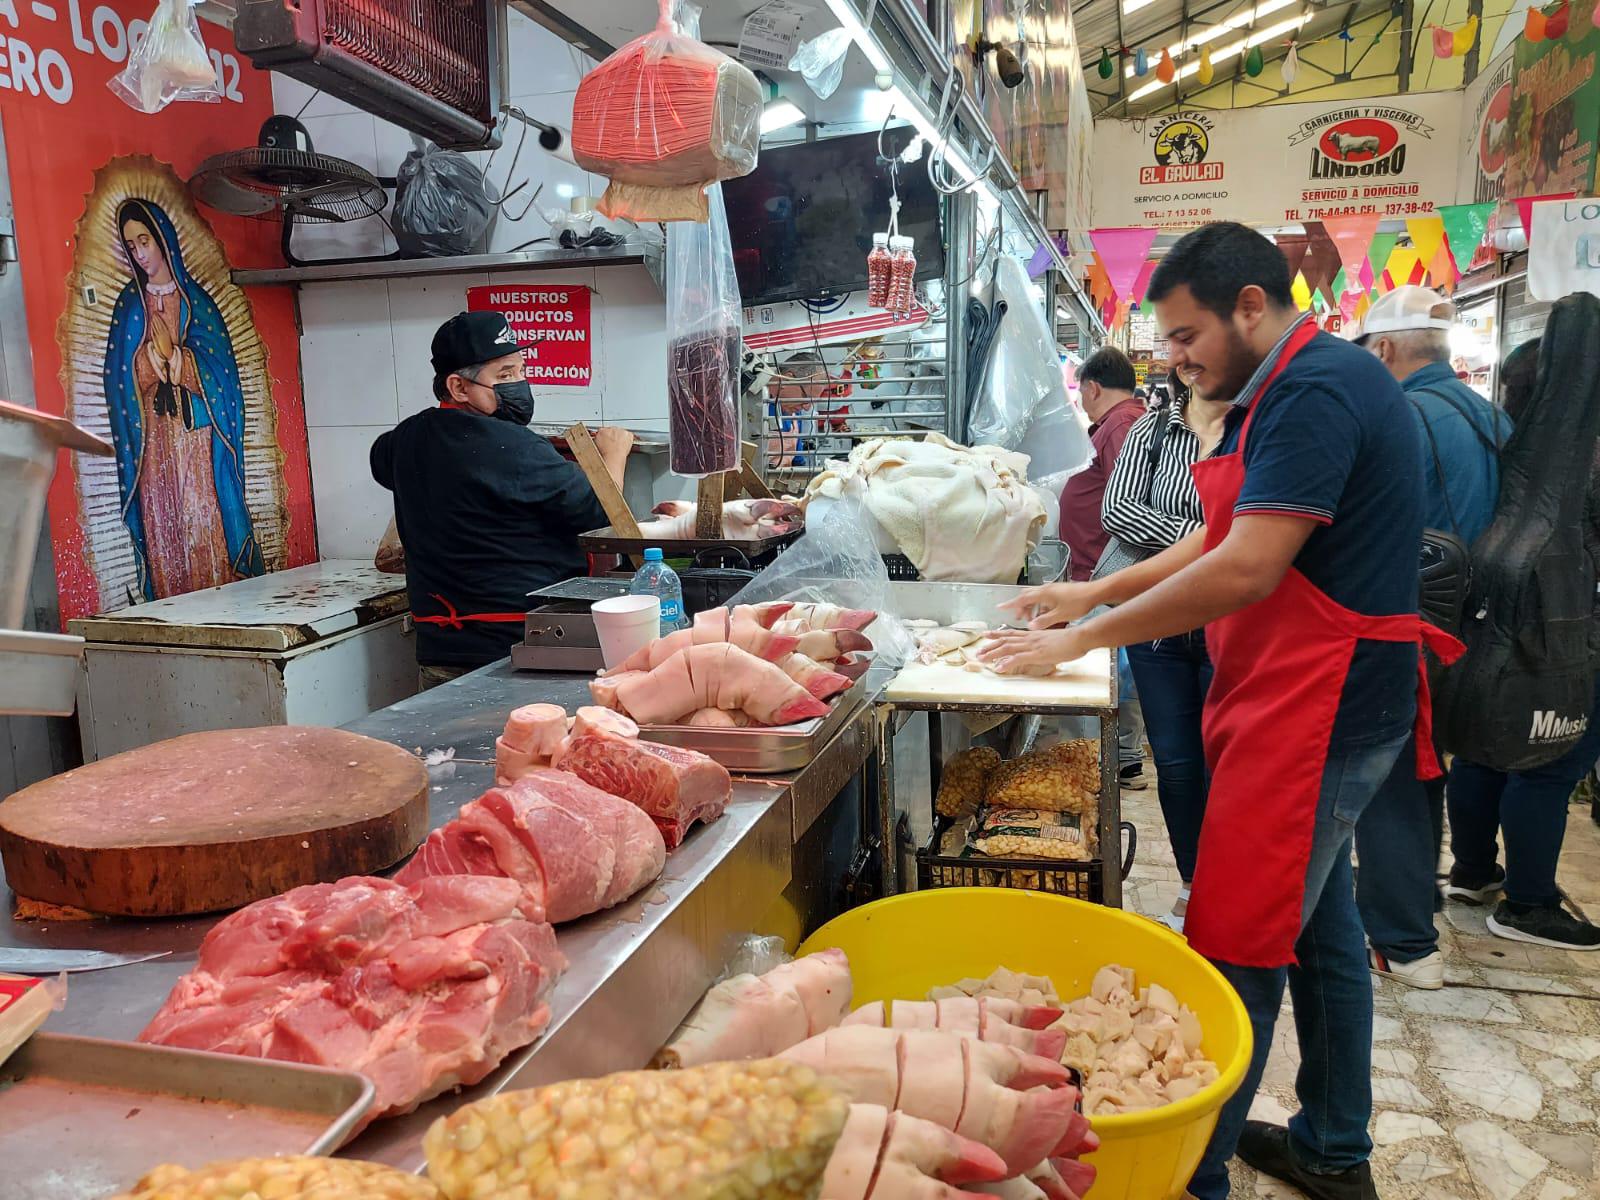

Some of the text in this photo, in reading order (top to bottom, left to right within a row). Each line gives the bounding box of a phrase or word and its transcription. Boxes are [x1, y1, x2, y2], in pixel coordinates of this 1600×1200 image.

[1304, 108, 1419, 131] CARNICERIA Y VISCERAS
[1309, 144, 1407, 180] LINDORO
[1142, 168, 1160, 183] EL
[1134, 195, 1171, 203] SERVICIO
[1182, 191, 1228, 200] DOMICILIO
[1302, 184, 1419, 201] SERVICIO A DOMICILIO
[1176, 209, 1185, 217] 13
[1188, 208, 1198, 216] 52
[1284, 209, 1303, 220] TEL.
[1386, 202, 1434, 215] 137-38-42
[490, 292, 569, 304] NUESTROS
[504, 310, 574, 323] ODUCTOS
[660, 604, 678, 617] ciel
